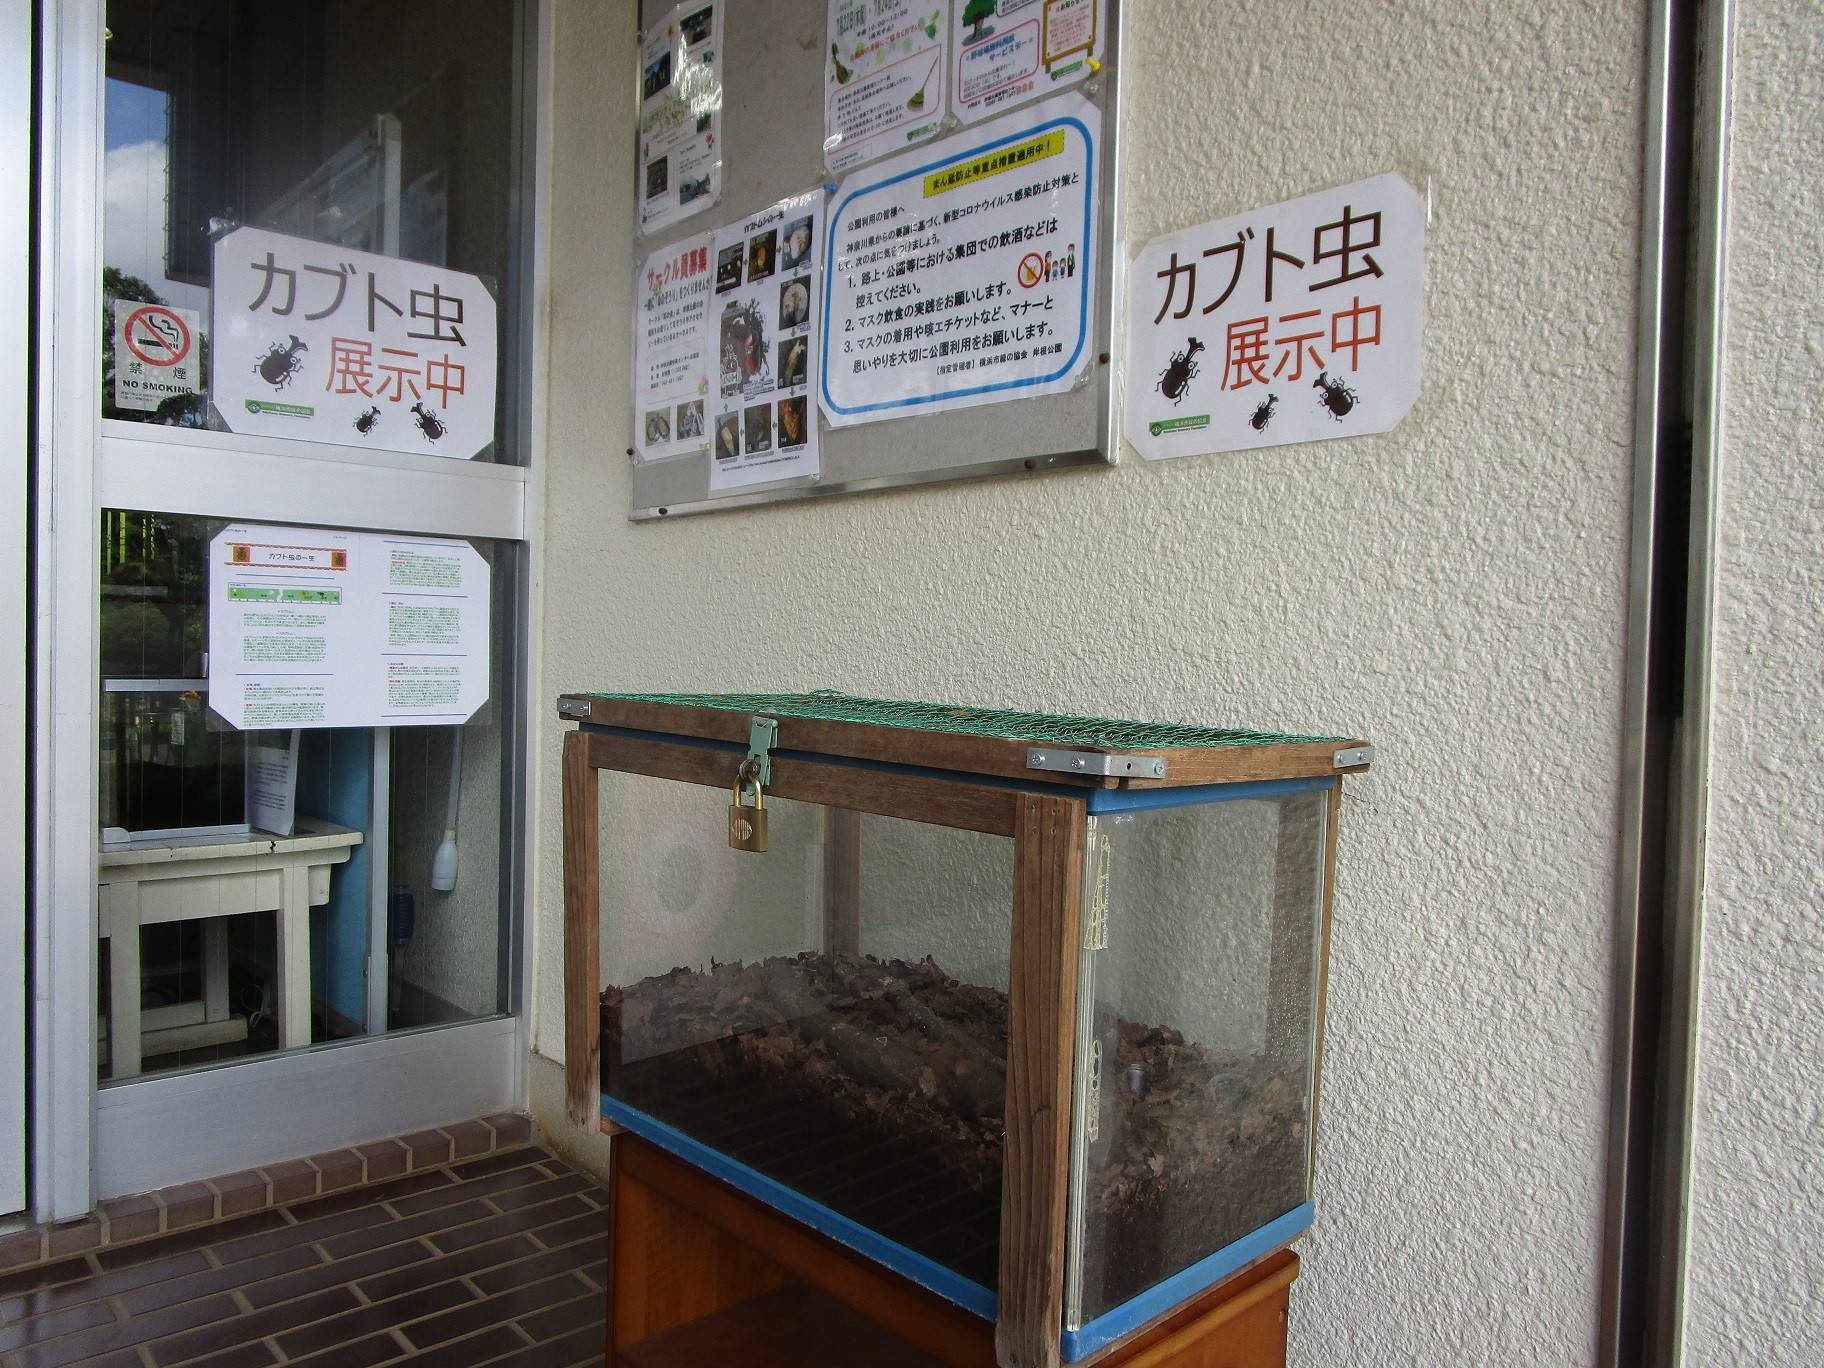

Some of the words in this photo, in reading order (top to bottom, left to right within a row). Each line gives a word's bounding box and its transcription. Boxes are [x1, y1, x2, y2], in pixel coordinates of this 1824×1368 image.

[847, 205, 905, 232] 公園利用の皆様へ
[647, 245, 708, 291] サークル員募集
[1153, 204, 1385, 326] カブト虫
[248, 252, 467, 346] カブト虫
[855, 281, 921, 309] 控えてください。
[858, 281, 1012, 328] マスク飲食の実践をお願いします。
[857, 295, 1053, 350] マスクの着用や咳エチケットなど、マナーと
[1220, 296, 1382, 392] 展示中
[129, 361, 143, 375] 禁
[172, 366, 187, 380] 煙
[853, 320, 1053, 374] 思いやりを大切に公園利用をお願いします。
[979, 349, 1028, 368] 横浜市緑の協会
[122, 379, 139, 389] NO
[142, 380, 193, 394] SMOKING
[325, 336, 465, 409] 展示中
